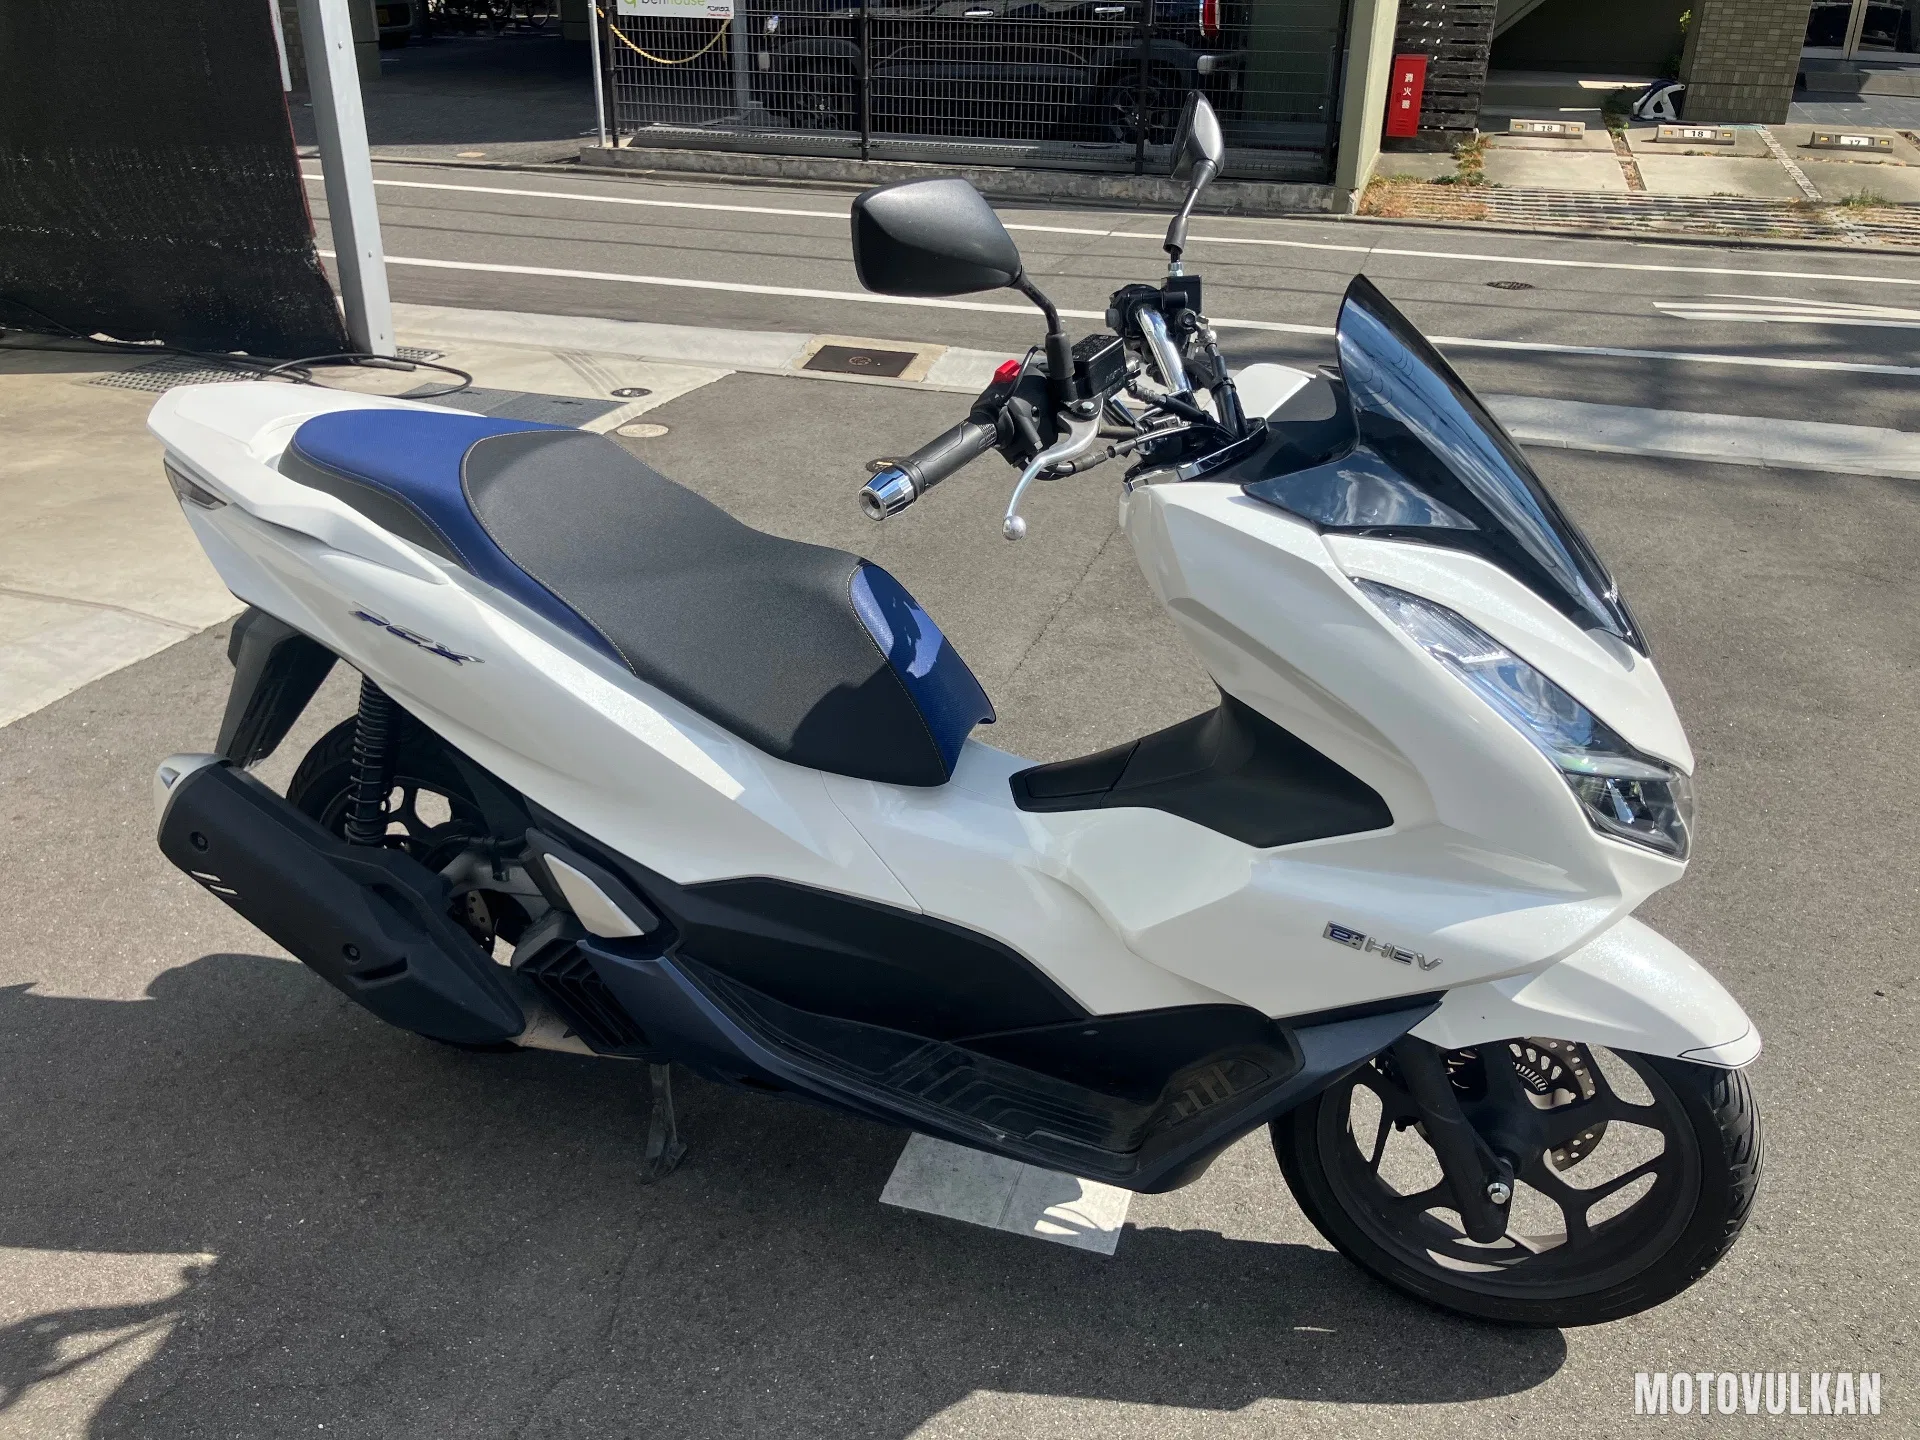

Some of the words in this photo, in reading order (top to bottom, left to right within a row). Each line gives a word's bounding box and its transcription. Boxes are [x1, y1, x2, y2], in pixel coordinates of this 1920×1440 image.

[1401, 72, 1414, 109] 消火器
[1691, 130, 1704, 138] 18
[347, 601, 486, 667] PCX
